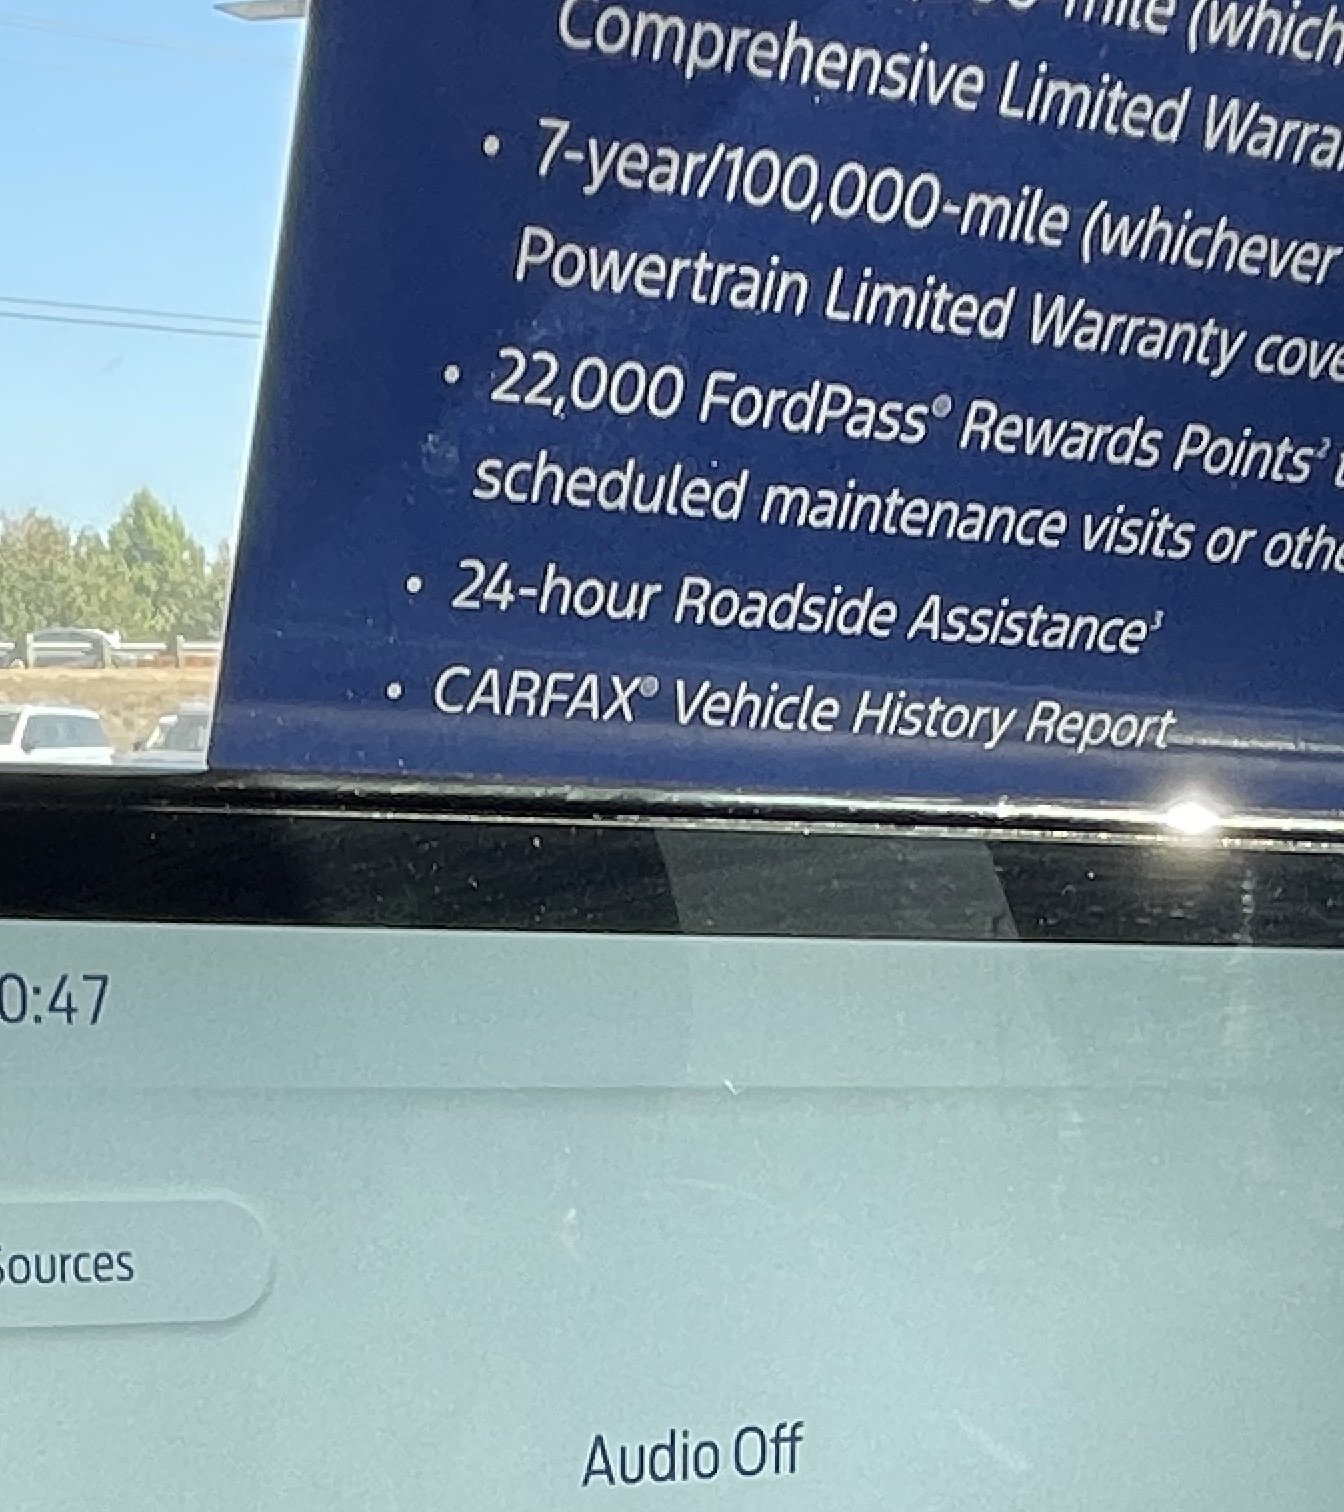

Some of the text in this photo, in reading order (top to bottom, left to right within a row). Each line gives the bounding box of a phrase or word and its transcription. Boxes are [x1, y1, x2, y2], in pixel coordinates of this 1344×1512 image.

[558, 0, 987, 112] Comprehensive
[998, 60, 1191, 142] Limited
[536, 116, 1069, 246] 7-year/100,000-mile
[1080, 199, 1340, 287] (whichever
[515, 225, 809, 315] Powertrain
[825, 266, 1013, 340] Limited
[1032, 294, 1246, 376] Warranty
[491, 348, 684, 418] 22,000
[961, 400, 1161, 469] Rewards
[473, 449, 747, 521] scheduled
[762, 481, 1067, 551] maintenance
[1080, 505, 1193, 560] visits
[1206, 523, 1256, 564] or
[452, 558, 660, 622] 24-hour
[675, 576, 895, 639] Roadside
[675, 679, 835, 733] Vehicle
[853, 690, 1013, 750] History
[1027, 701, 1177, 755] Report
[582, 1420, 805, 1487] Audio Off
